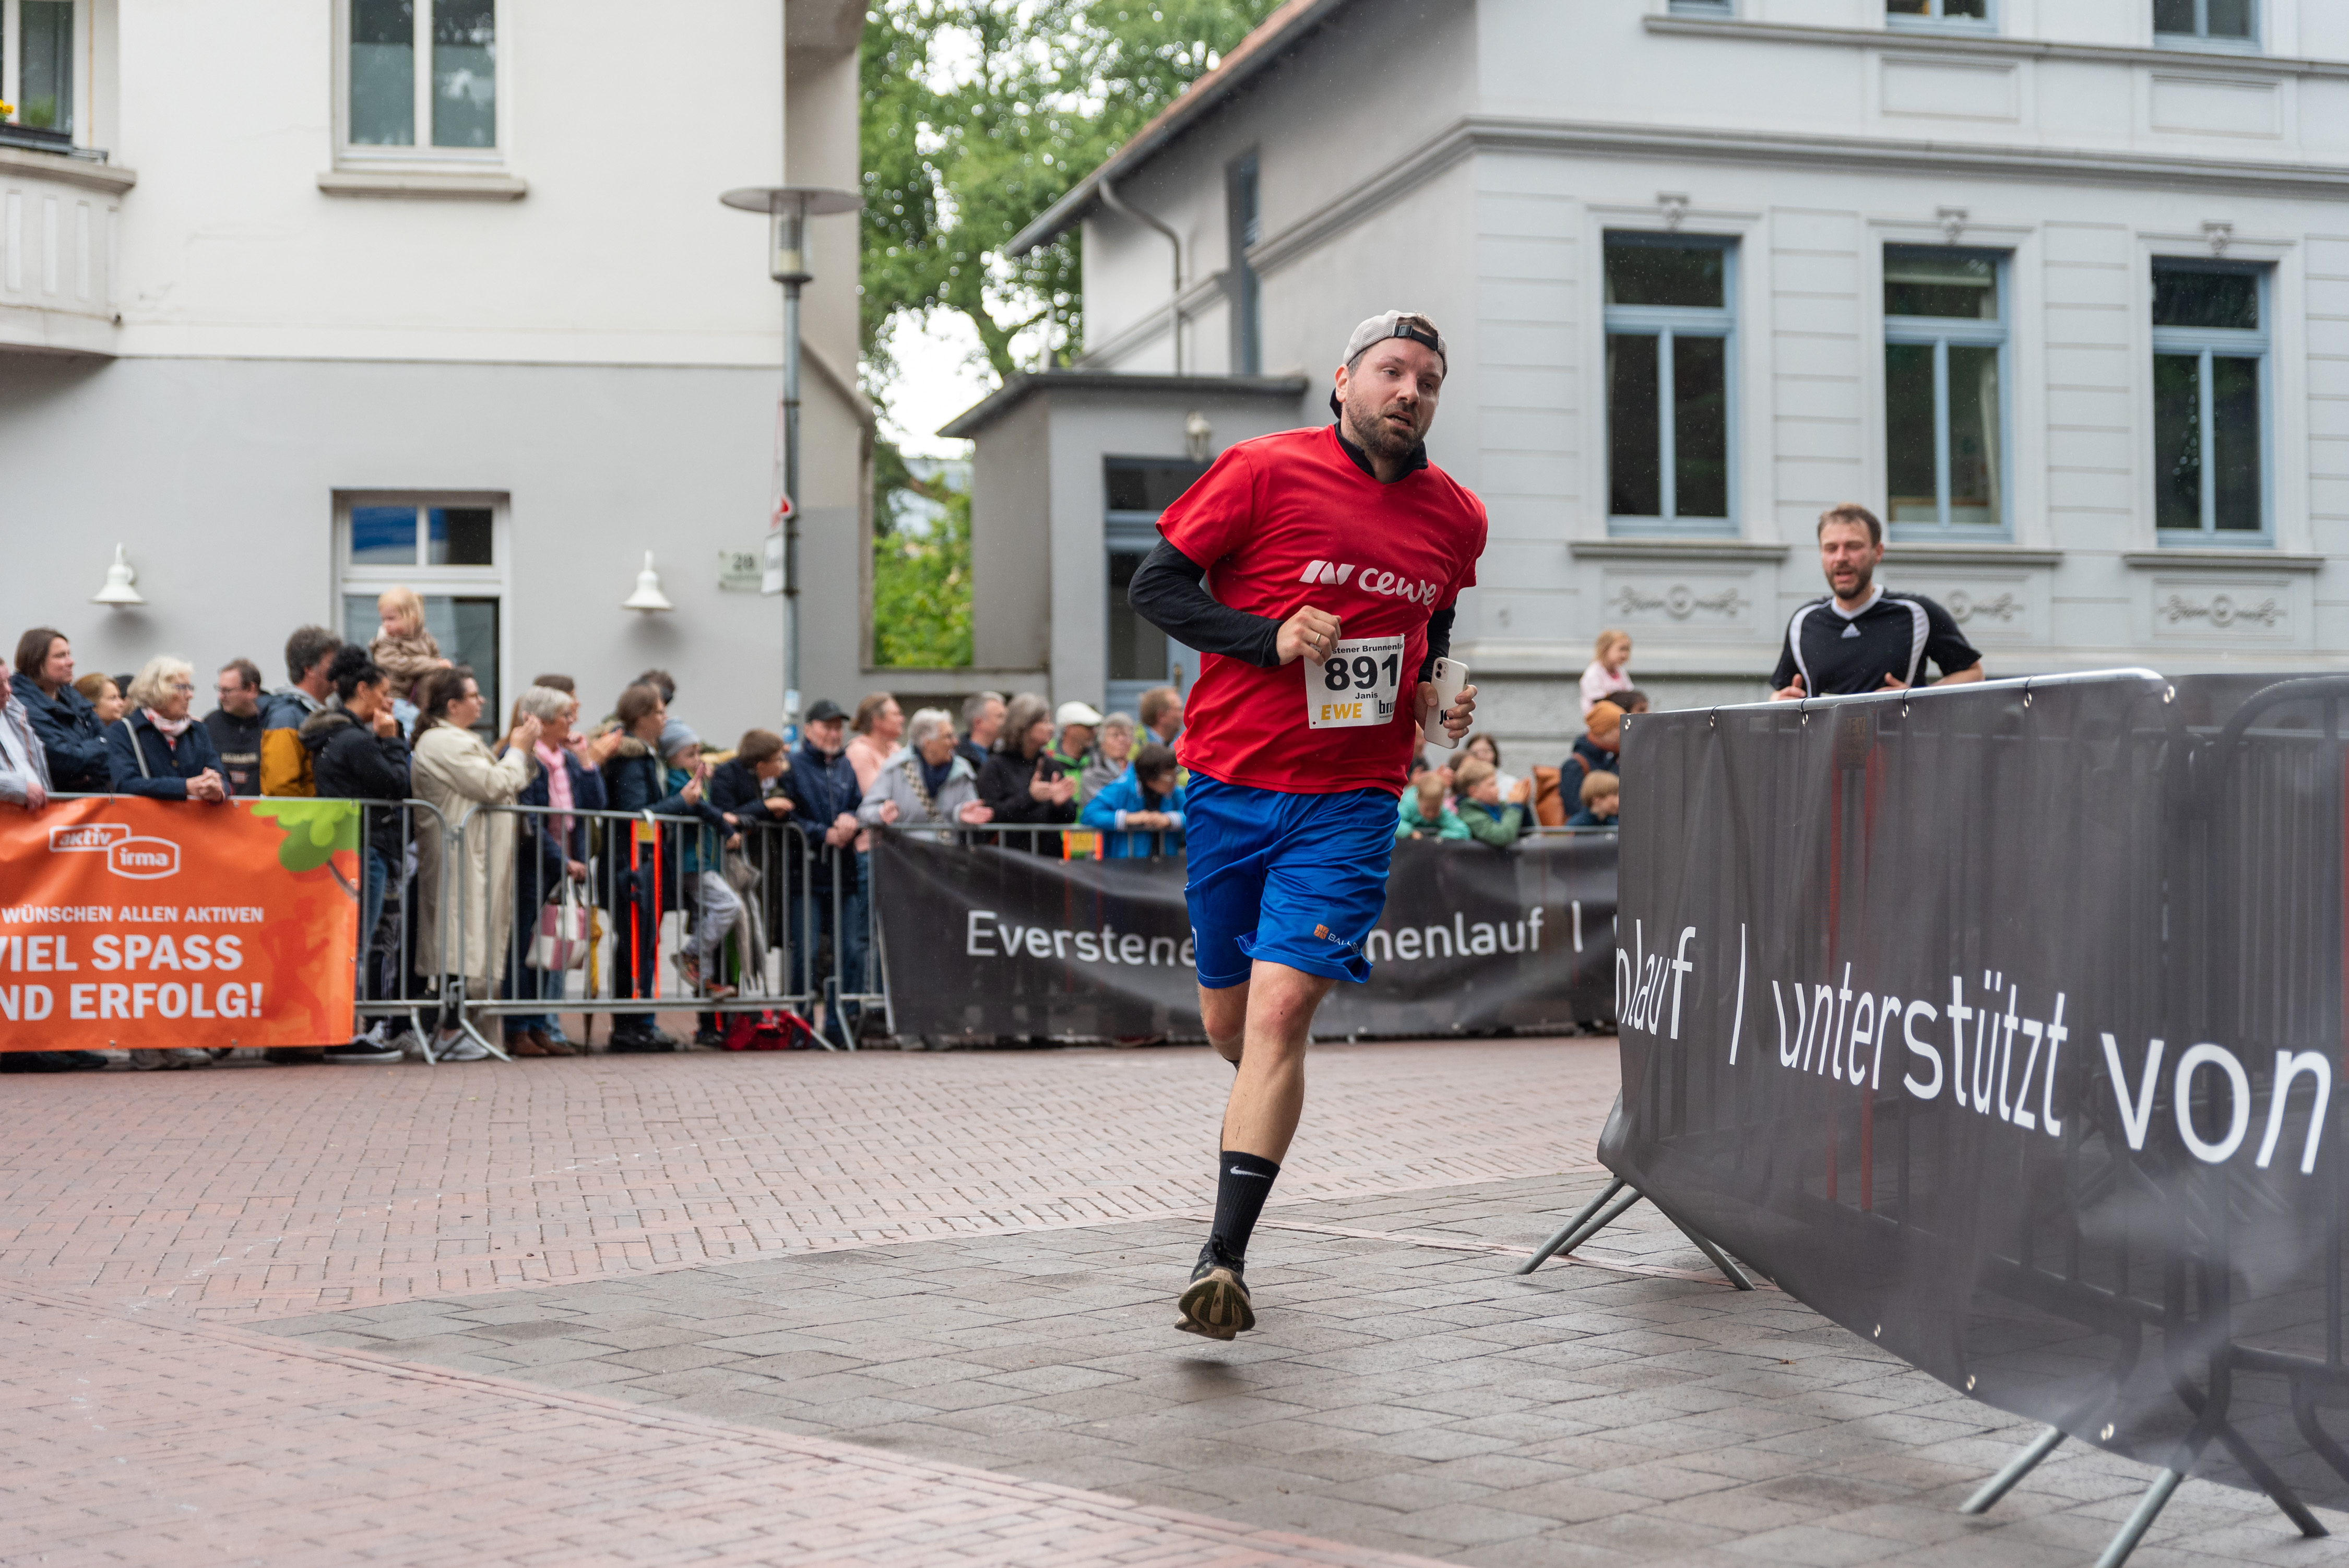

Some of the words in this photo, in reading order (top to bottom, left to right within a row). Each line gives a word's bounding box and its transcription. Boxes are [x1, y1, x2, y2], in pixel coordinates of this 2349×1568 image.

[1358, 568, 1437, 605] cewe
[1324, 653, 1398, 691] 891
[1321, 703, 1362, 720] EWE
[59, 827, 112, 846] aktiv
[120, 847, 169, 866] irma
[1, 904, 113, 924] WÜNSCHEN
[118, 906, 179, 922] ALLEN
[183, 906, 264, 923] AKTIVEN
[0, 935, 78, 972] IEL
[91, 934, 243, 971] SPASS
[70, 982, 263, 1019] ERFOLG!
[1772, 961, 2068, 1137] unterstützt
[2101, 1032, 2331, 1174] von
